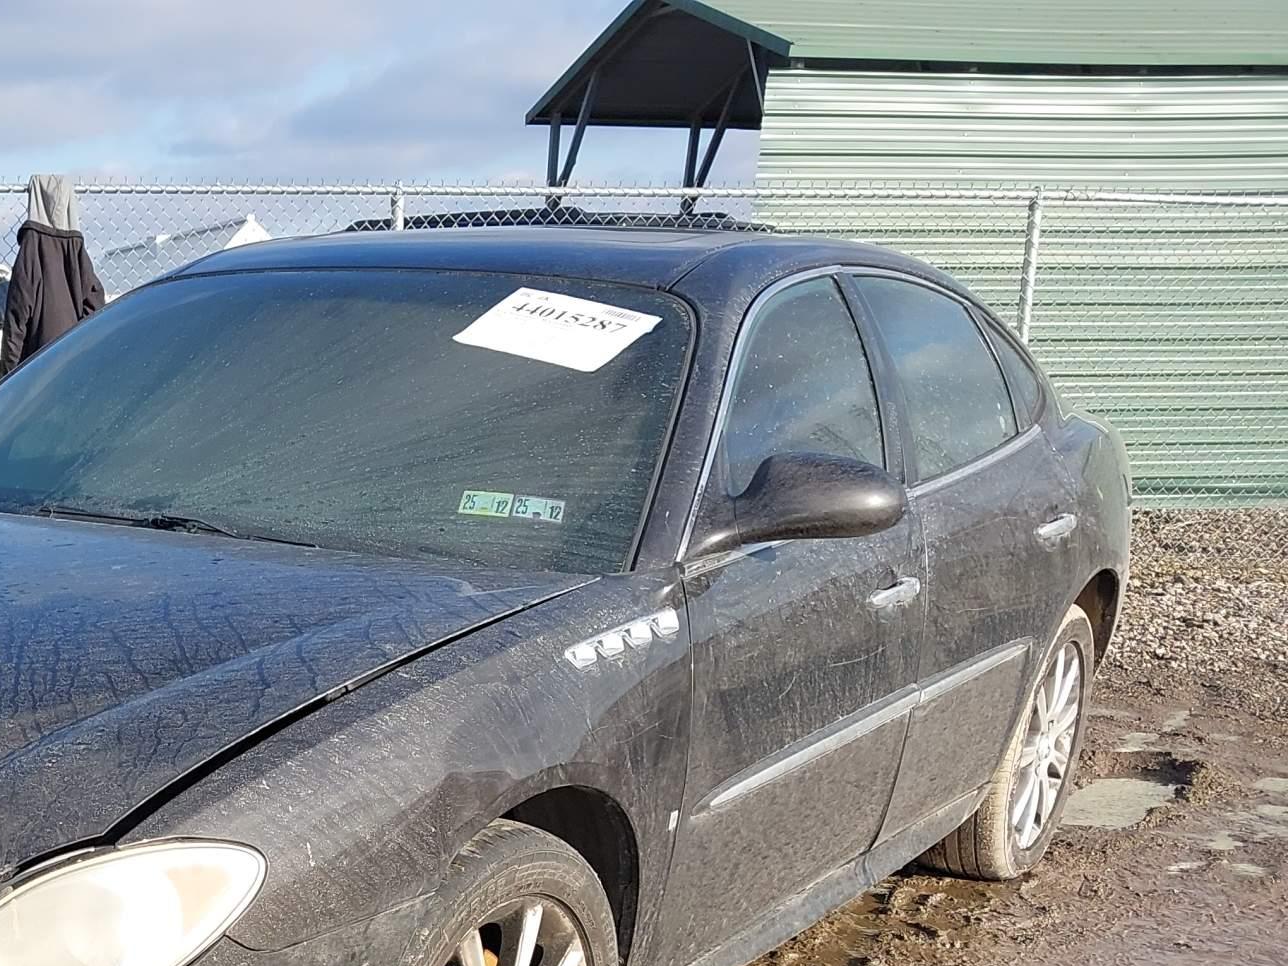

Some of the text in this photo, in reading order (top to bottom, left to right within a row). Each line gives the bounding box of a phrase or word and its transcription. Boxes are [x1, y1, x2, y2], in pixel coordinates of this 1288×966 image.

[511, 301, 628, 334] 44015287
[462, 494, 509, 514] 25 12
[515, 498, 562, 521] 25 12
